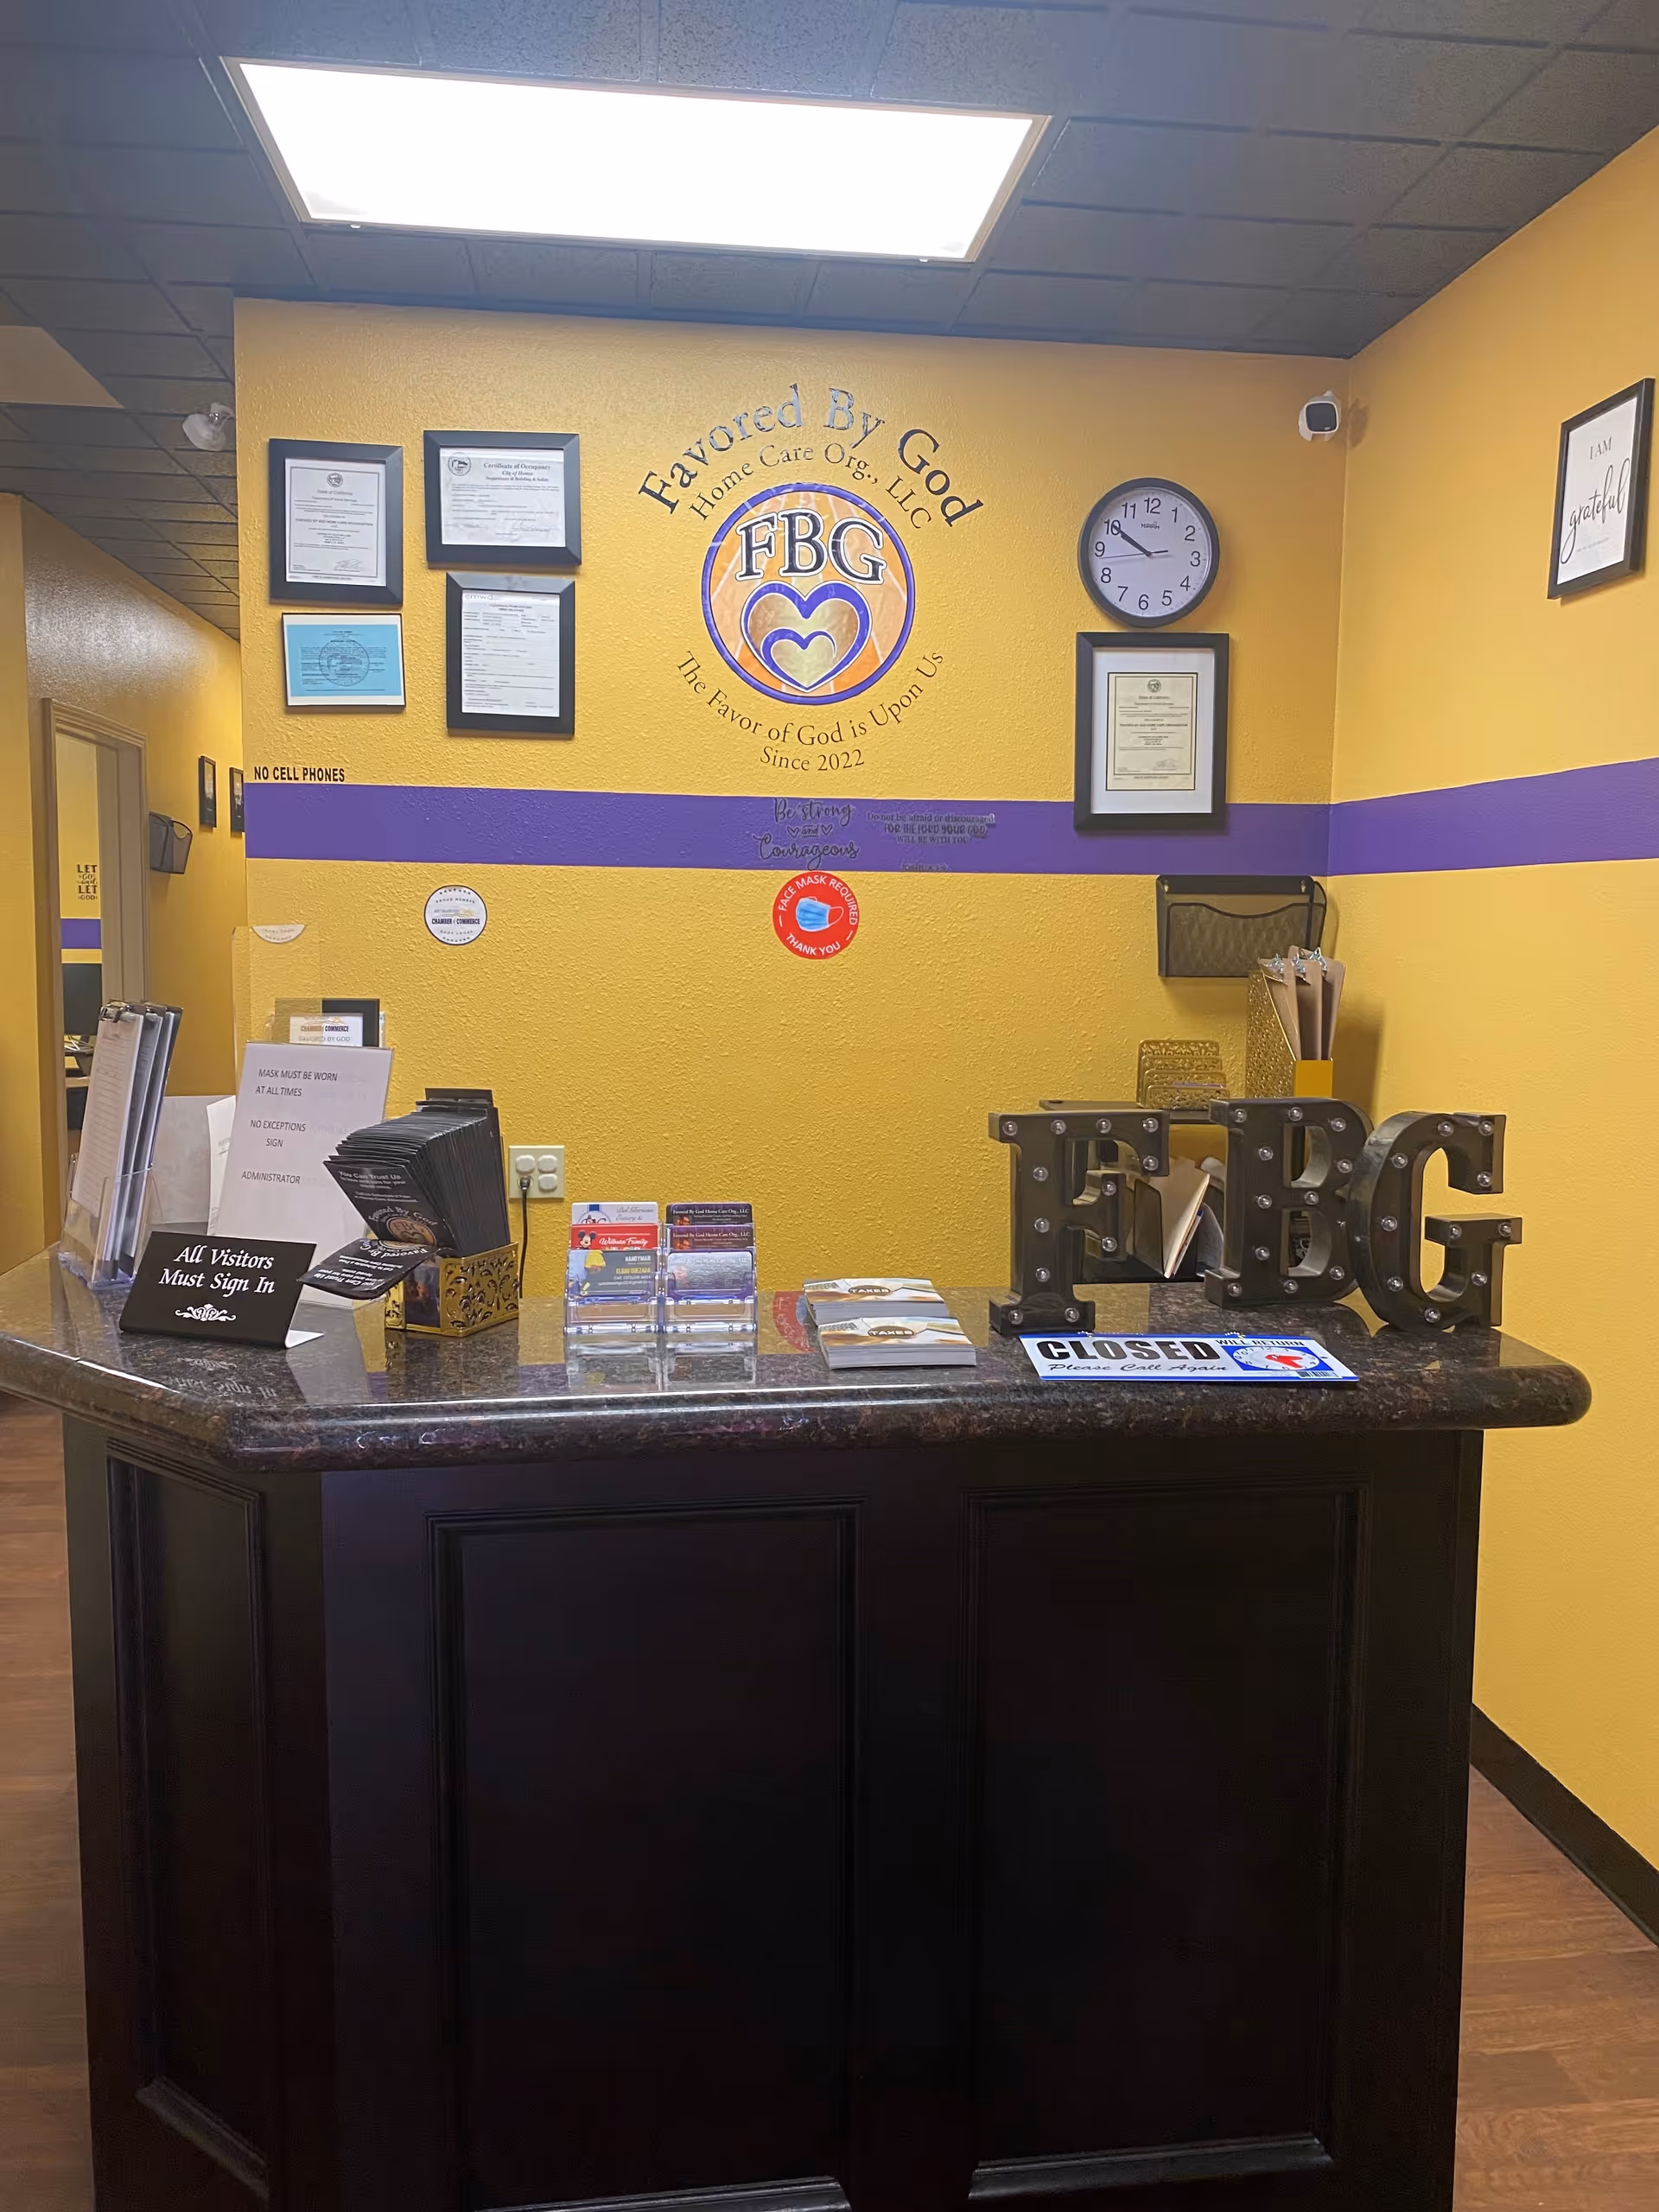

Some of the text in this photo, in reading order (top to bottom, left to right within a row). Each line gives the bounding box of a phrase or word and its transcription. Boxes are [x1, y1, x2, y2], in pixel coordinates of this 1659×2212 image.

[639, 383, 984, 527] Favored By God
[1589, 436, 1612, 460] I AM
[689, 442, 932, 529] Home Care Org., LLC
[1122, 502, 1136, 518] 11
[1144, 498, 1161, 514] 12
[1560, 457, 1630, 564] grateful
[1172, 507, 1178, 523] 1
[1104, 518, 1122, 536] 10
[1185, 525, 1196, 542] 2
[735, 509, 886, 584] FBG
[1095, 541, 1105, 557] 9
[1190, 550, 1201, 567] 3
[1101, 567, 1112, 583] 8
[1180, 575, 1191, 591] 4
[1117, 586, 1128, 602] 7
[1138, 594, 1149, 610] 6
[1161, 590, 1173, 606] 5
[677, 650, 944, 746] The Favor of God is Upon Us
[760, 746, 865, 772] Since 2022
[254, 766, 345, 782] NO CELL PHONES
[773, 798, 855, 827] Be strong
[909, 813, 932, 822] afraid
[802, 824, 819, 835] and
[884, 823, 900, 833] FOR
[903, 823, 915, 834] THE
[941, 823, 966, 835] YOUR
[929, 836, 950, 844] WITH
[952, 836, 969, 844] YOU
[752, 833, 860, 871] Courageous
[77, 864, 98, 873] LET
[79, 885, 98, 893] LET
[778, 875, 858, 925] FACE MASK REQUIRED
[785, 932, 841, 956] THANK YOU
[258, 1069, 279, 1077] MASK
[281, 1071, 302, 1079] MUST
[314, 1072, 338, 1081] WORN
[280, 1087, 302, 1096] TIMES
[263, 1121, 306, 1131] EXCEPTIONS
[266, 1138, 283, 1147] SIGN
[241, 1171, 301, 1184] ADMINISTRATOR
[174, 1244, 274, 1269] All Visitors
[158, 1268, 275, 1298] Must Sign In
[1037, 1340, 1221, 1360] CLOSED
[1168, 1363, 1228, 1372] Again
